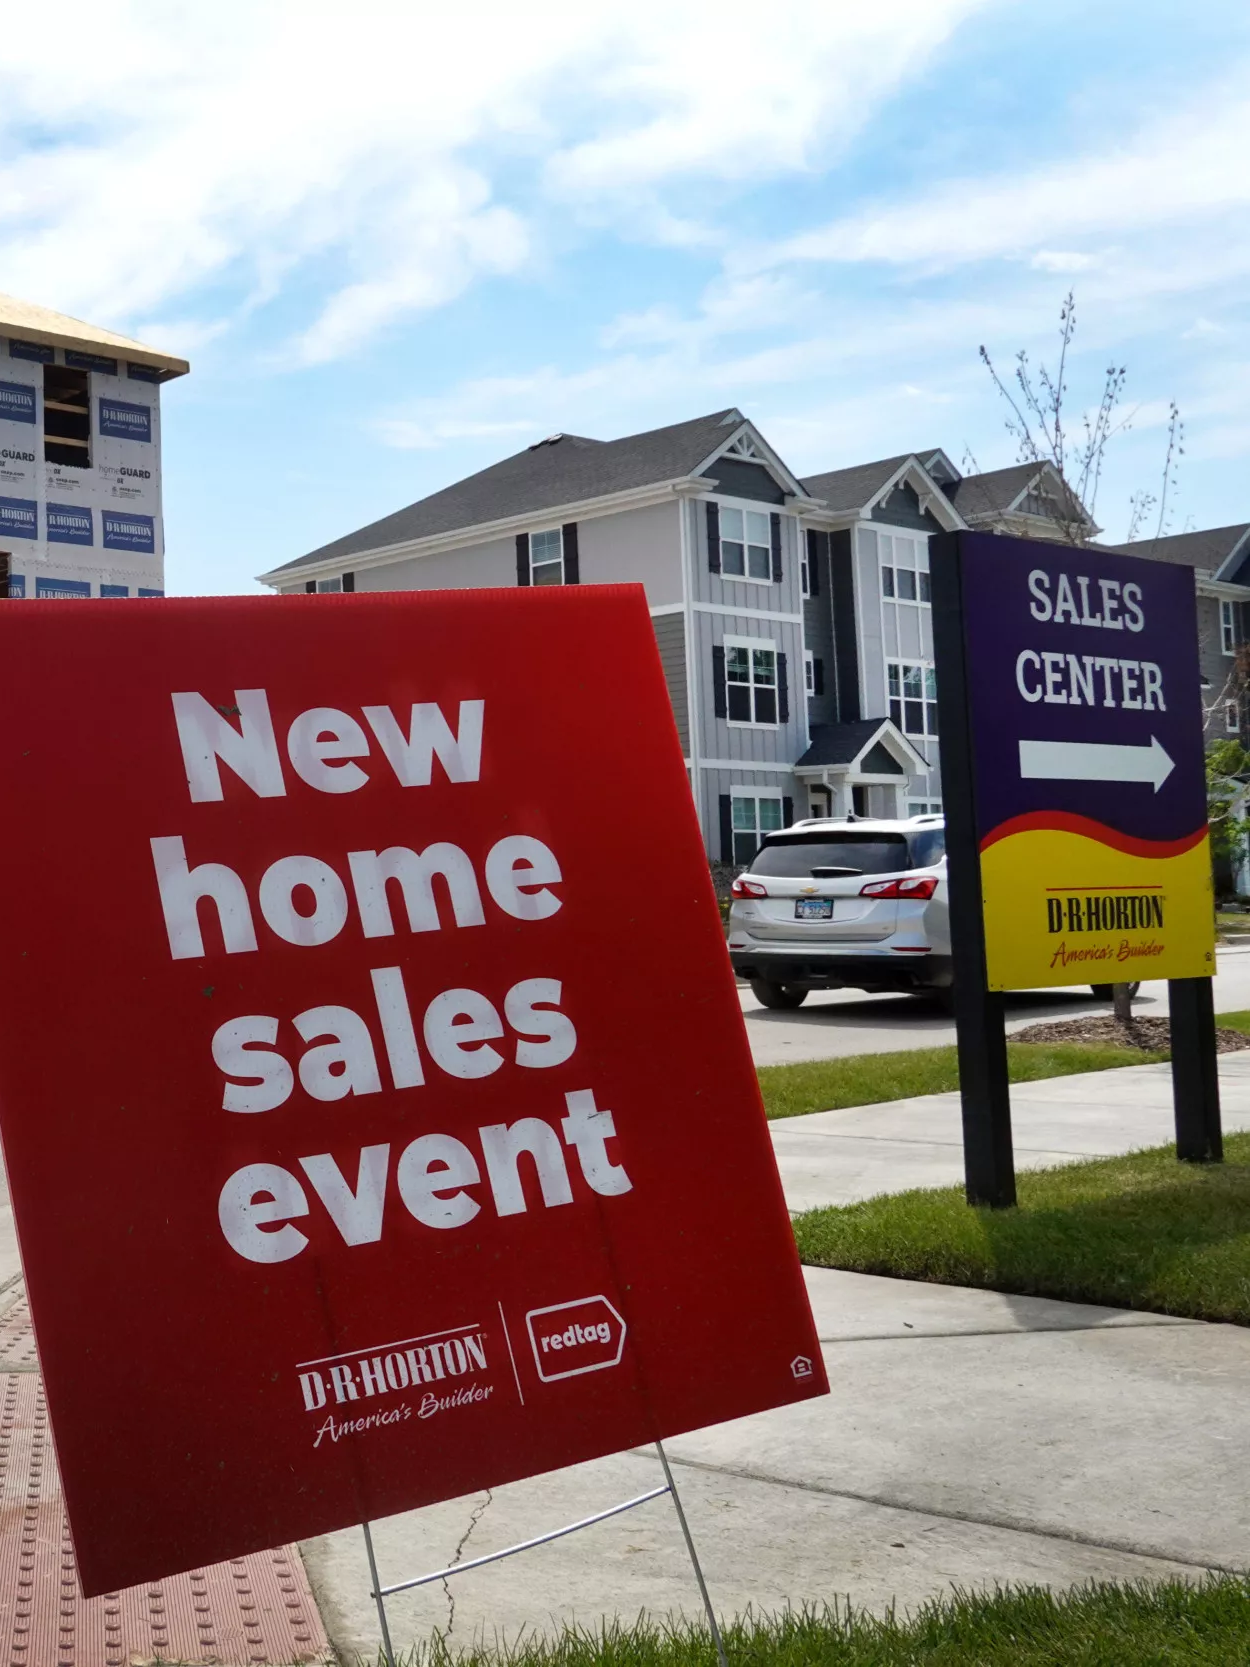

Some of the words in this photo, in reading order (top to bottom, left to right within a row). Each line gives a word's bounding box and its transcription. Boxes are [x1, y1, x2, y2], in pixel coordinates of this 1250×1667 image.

[99, 465, 150, 480] homeGUARD
[1027, 568, 1145, 633] SALES
[1015, 649, 1167, 712] CENTER
[171, 688, 485, 803] New
[150, 835, 563, 960] home
[1050, 941, 1114, 968] America's
[1116, 939, 1165, 962] Builder
[211, 966, 577, 1113] sales
[218, 1088, 633, 1264] event
[540, 1321, 611, 1353] redtag
[313, 1403, 411, 1448] America's
[417, 1382, 494, 1419] Builder
